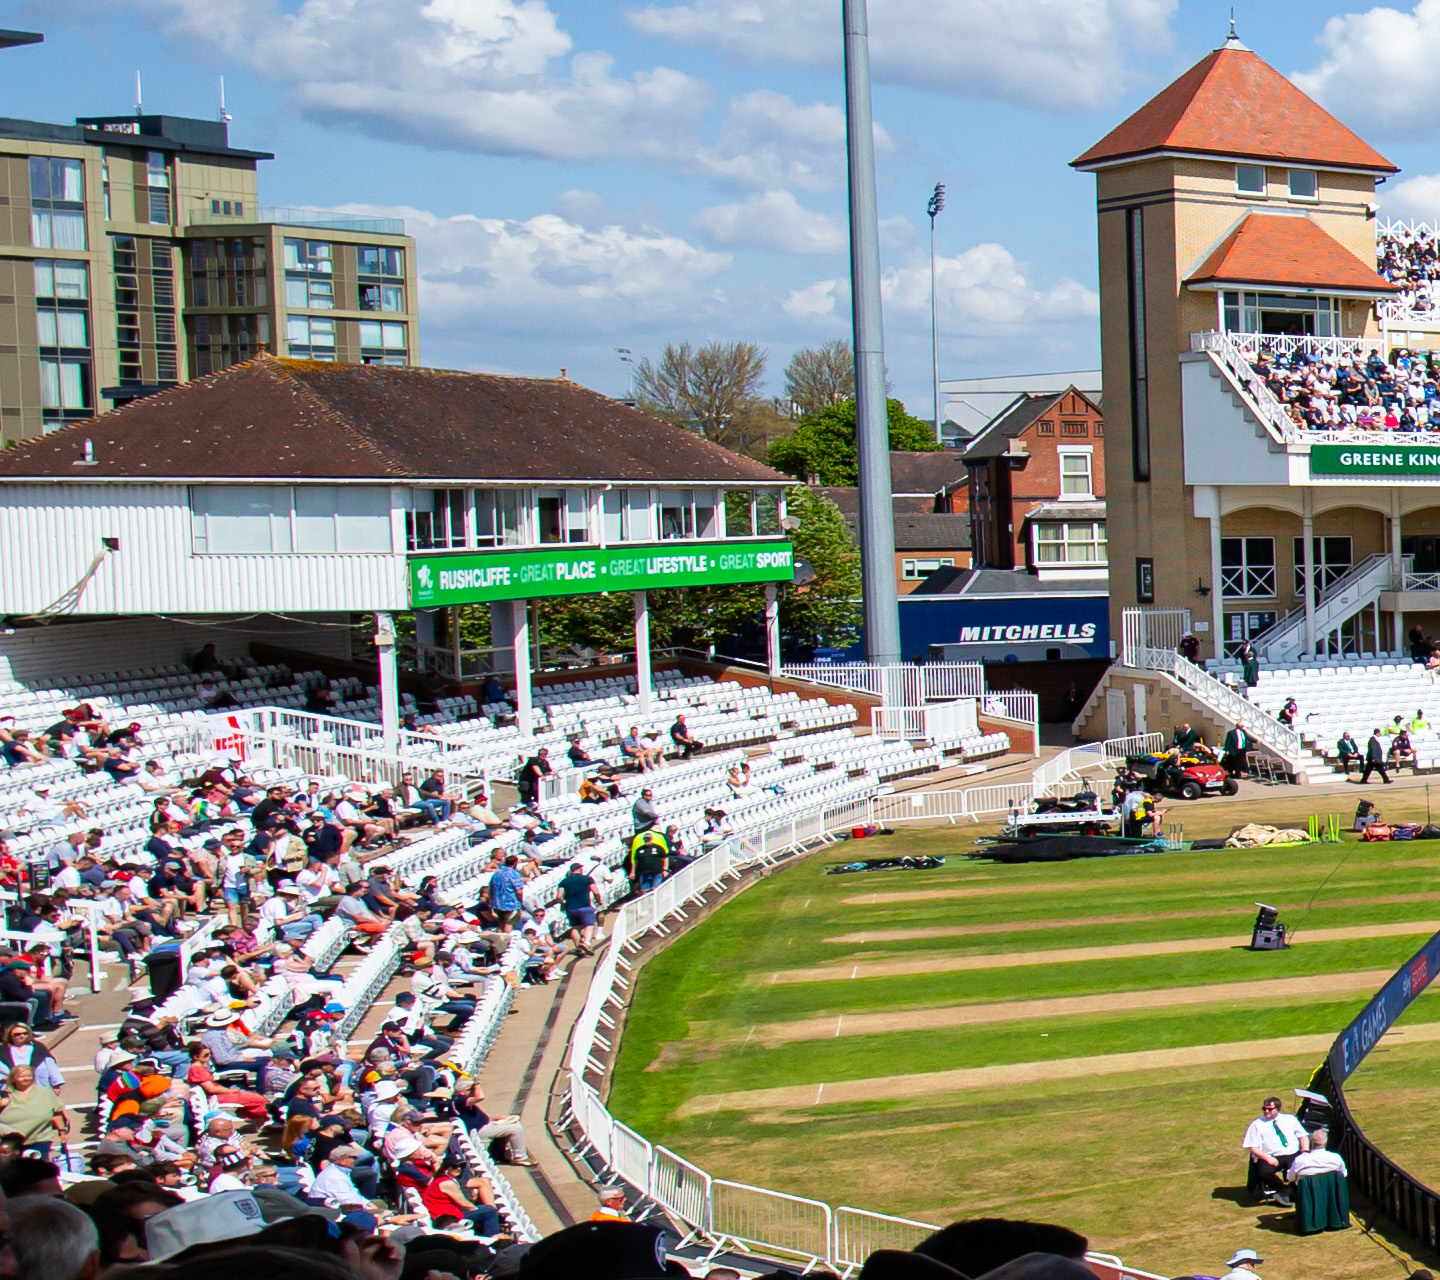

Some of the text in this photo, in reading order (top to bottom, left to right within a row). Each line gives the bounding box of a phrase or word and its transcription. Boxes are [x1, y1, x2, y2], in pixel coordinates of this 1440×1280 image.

[1340, 453, 1403, 466] GREENE
[440, 551, 793, 589] RUSHCLIFFE GREAT PLACE GREAT LIFESTYLE GREAT SPORT
[960, 623, 1097, 641] MITCHELLS
